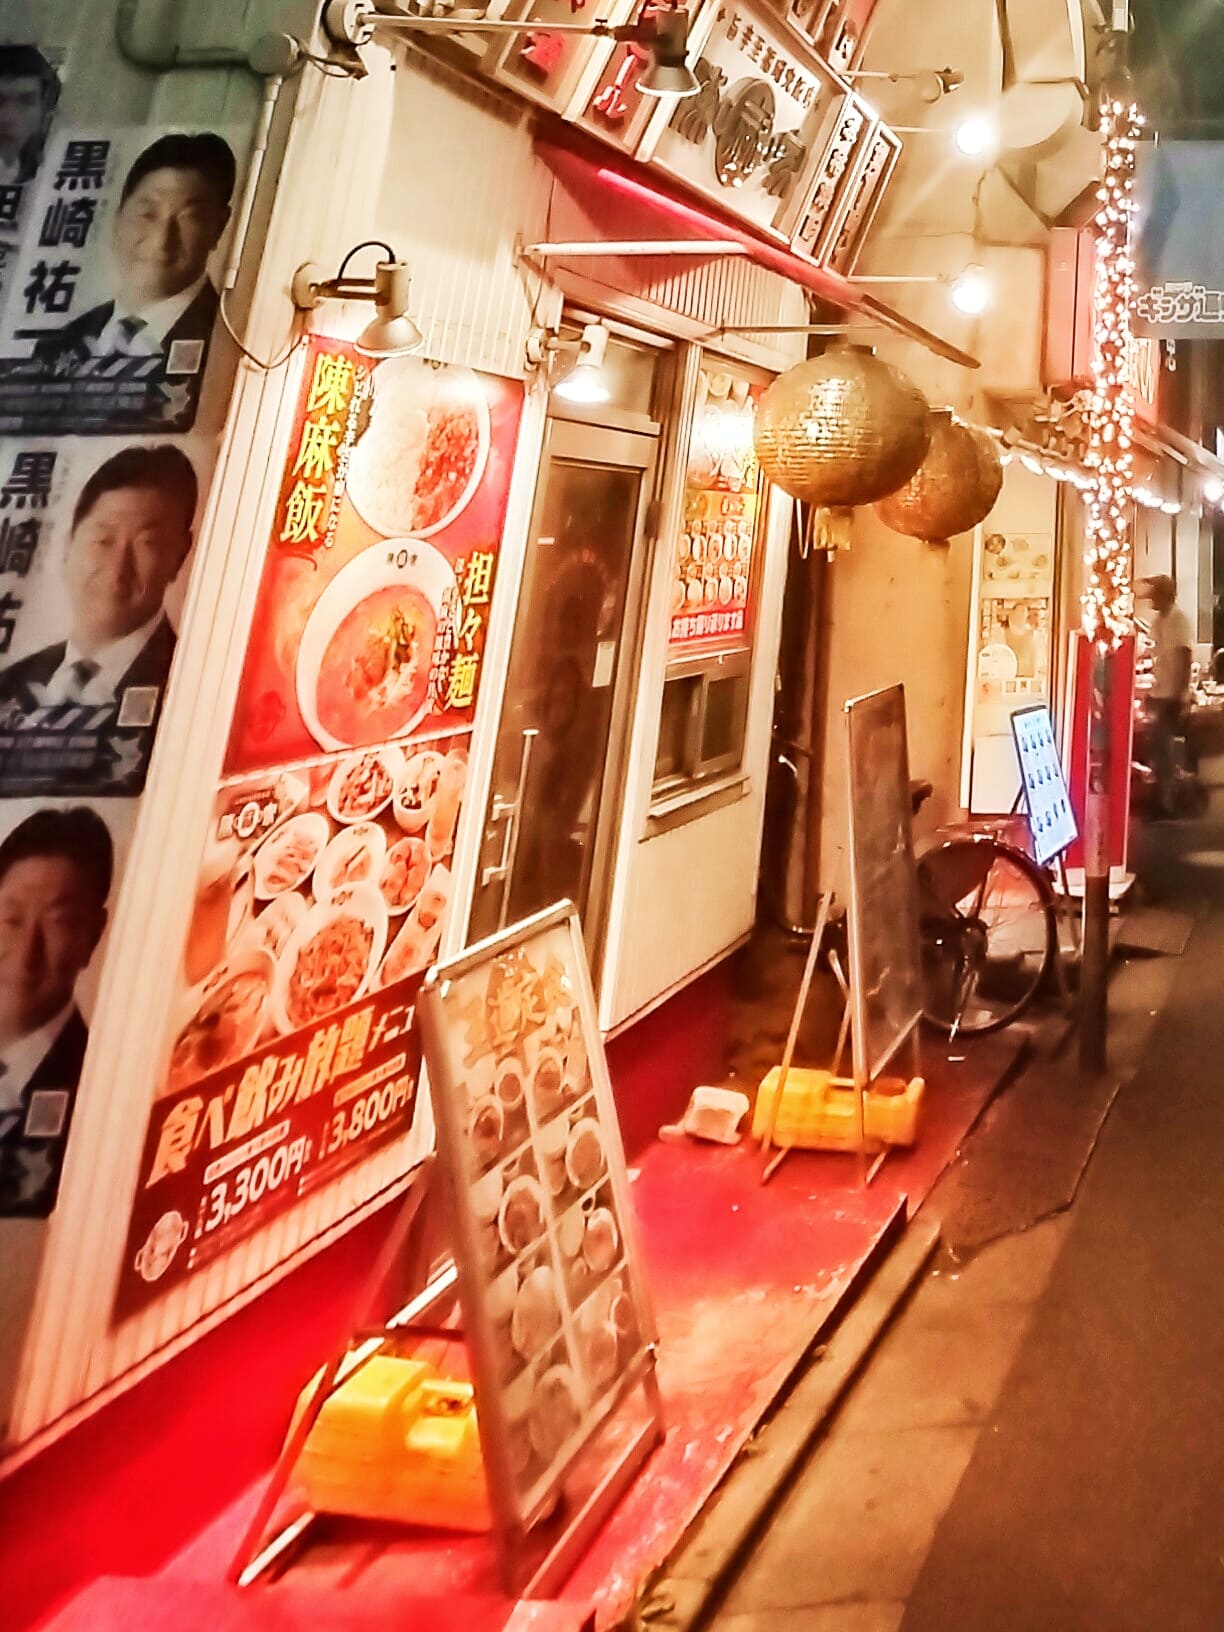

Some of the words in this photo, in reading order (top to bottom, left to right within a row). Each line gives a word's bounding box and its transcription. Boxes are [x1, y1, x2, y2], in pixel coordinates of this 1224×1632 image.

[279, 352, 353, 544] 陳麻飯
[444, 551, 494, 709] 担々麺
